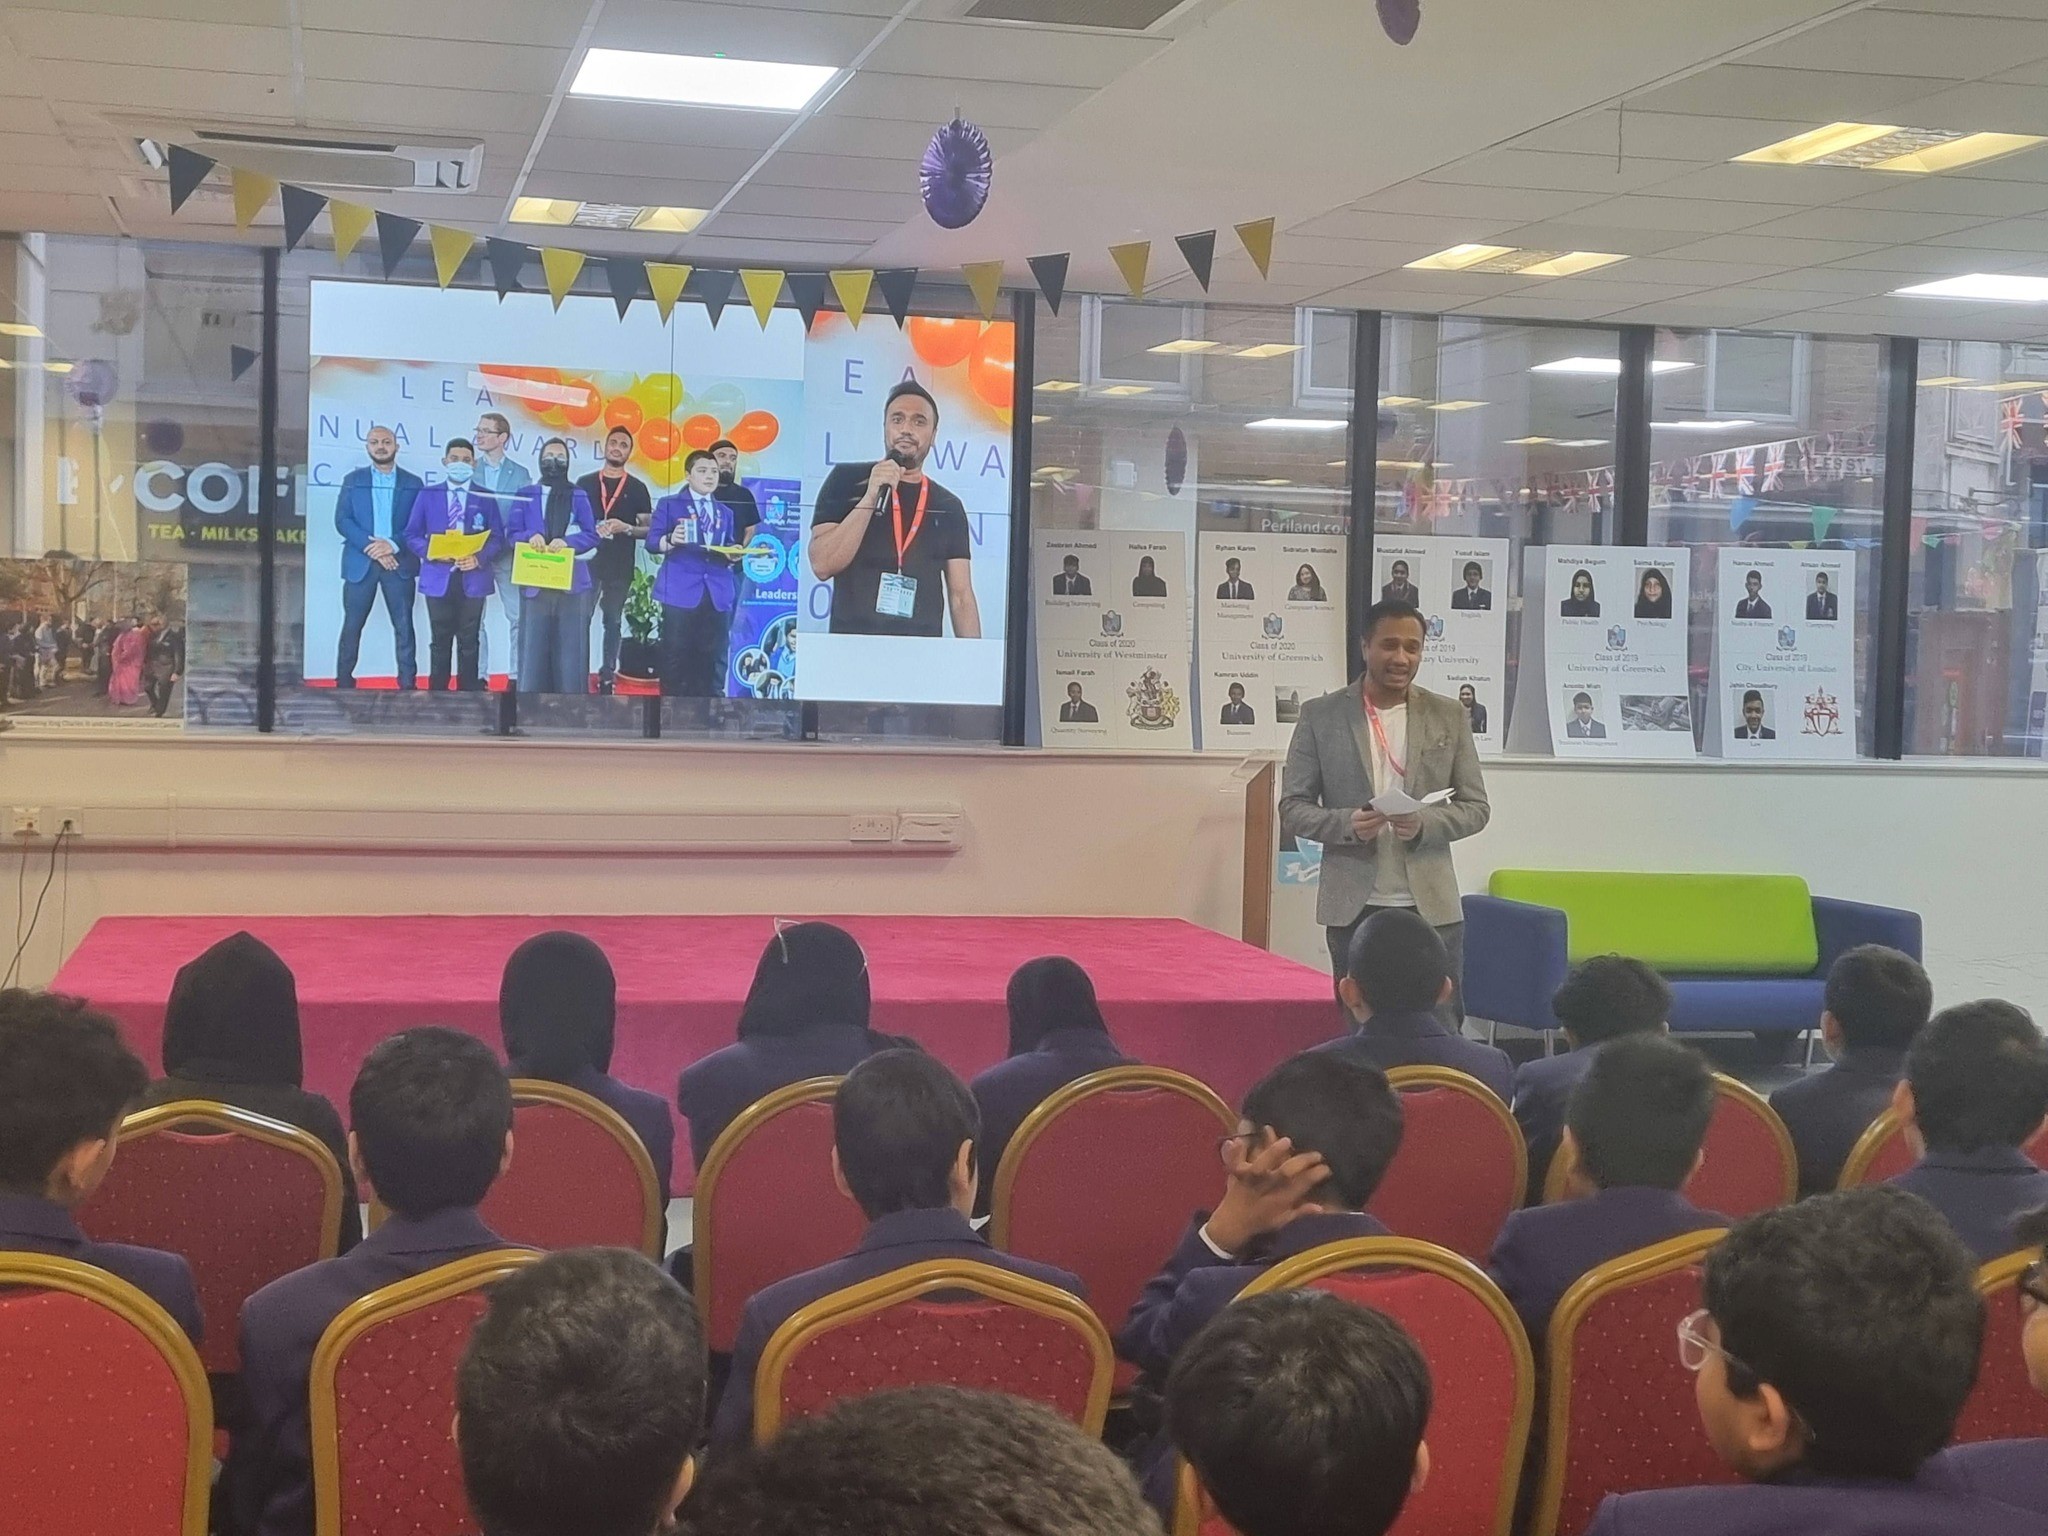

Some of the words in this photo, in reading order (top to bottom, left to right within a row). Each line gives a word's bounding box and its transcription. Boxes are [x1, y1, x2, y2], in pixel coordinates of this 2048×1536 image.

[148, 523, 185, 540] TEA
[201, 525, 306, 544] MILKSAKE
[1089, 639, 1108, 648] Class
[1110, 639, 1117, 648] of
[1250, 641, 1269, 650] Class
[1271, 641, 1278, 650] of
[1279, 642, 1296, 650] 2020
[1440, 644, 1456, 653] 2019
[1057, 650, 1101, 660] University
[1104, 650, 1113, 659] of
[1114, 651, 1168, 660] Westminster
[1222, 652, 1265, 662] University
[1267, 652, 1276, 661] of
[1278, 653, 1324, 662] Greenwich
[1595, 653, 1613, 661] Class
[1614, 653, 1621, 661] of
[1766, 653, 1783, 661] Class
[1784, 653, 1791, 661] of
[1438, 655, 1479, 665] University
[1567, 664, 1609, 673] University
[1611, 664, 1619, 672] of
[1622, 664, 1666, 673] Greenwich
[1756, 664, 1795, 673] University
[1797, 664, 1805, 672] of
